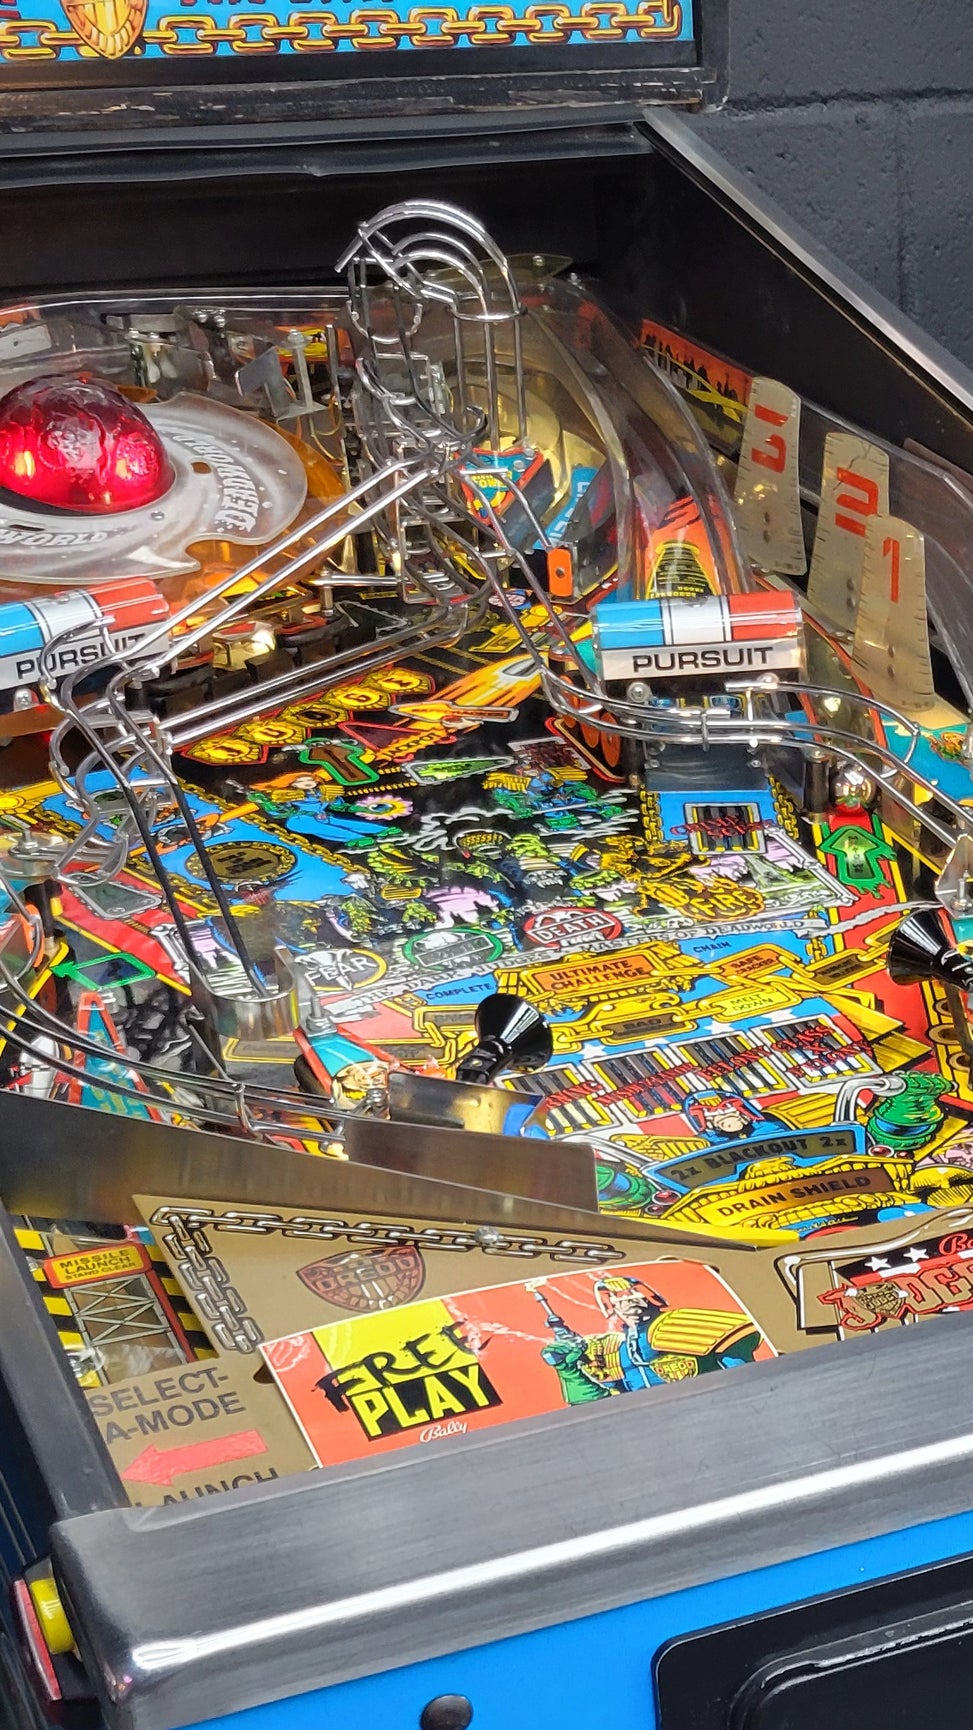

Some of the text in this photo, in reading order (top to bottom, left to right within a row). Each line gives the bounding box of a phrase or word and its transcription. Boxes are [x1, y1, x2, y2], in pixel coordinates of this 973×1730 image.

[632, 647, 773, 674] PURSUIT
[689, 889, 752, 917] FIRE
[540, 915, 606, 943] DEATH
[304, 955, 378, 987] FEAR
[425, 940, 732, 1000] COMPLETE CHAIN
[549, 967, 651, 992] CHALLENGE
[550, 959, 633, 982] ULTIMATE
[729, 993, 764, 1006] MELT
[704, 1137, 810, 1169] BLACKOUT
[716, 1173, 872, 1218] DRAIN SHIELD
[59, 1248, 130, 1269] MISSILE
[65, 1256, 132, 1276] LAUNCH
[312, 1320, 490, 1413] FREE
[88, 1366, 230, 1417] SELECT-
[350, 1363, 492, 1436] PLAY
[106, 1391, 247, 1445] A-MODE
[419, 1420, 469, 1444] Bally
